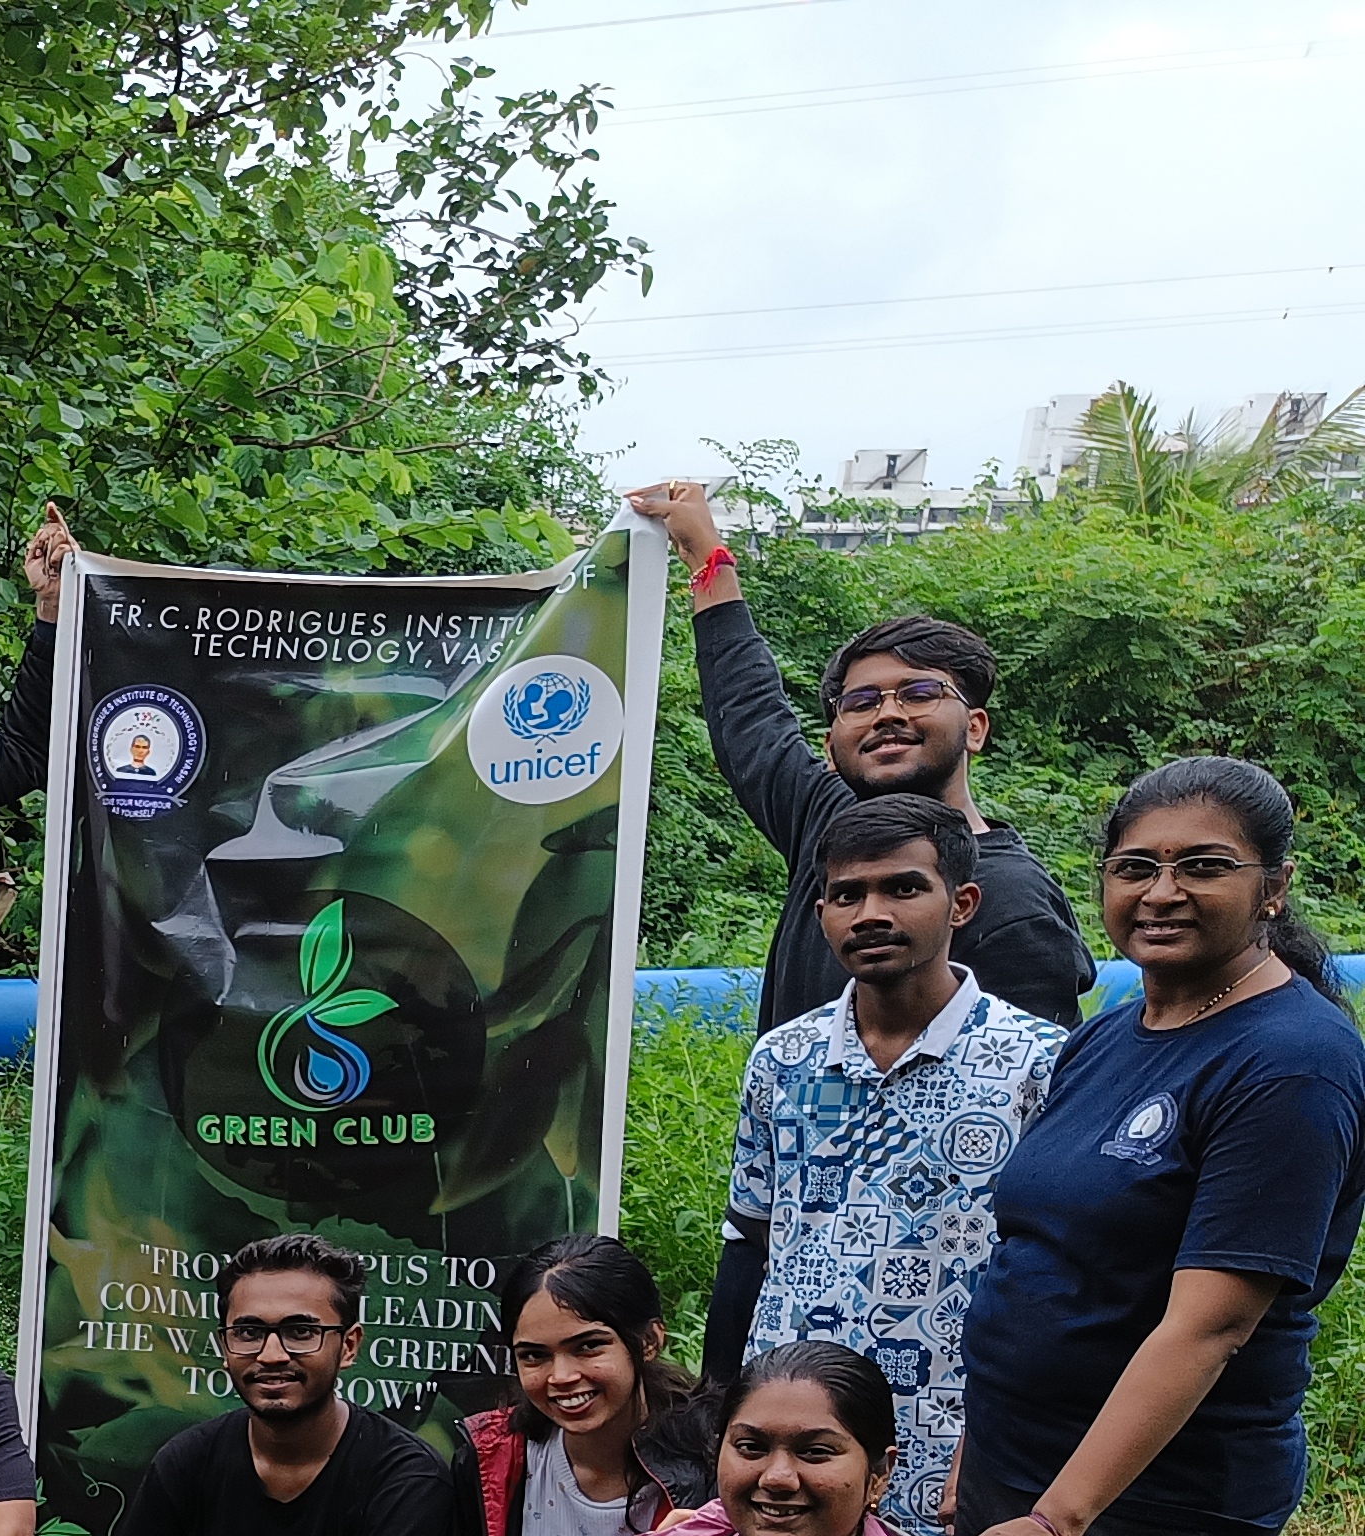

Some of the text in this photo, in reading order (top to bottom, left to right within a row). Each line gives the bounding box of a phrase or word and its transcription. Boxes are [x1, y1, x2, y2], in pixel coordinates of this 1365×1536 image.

[405, 612, 535, 638] INSTITU
[114, 690, 156, 706] INSTITUTE
[490, 742, 602, 785] unicef
[196, 1113, 436, 1147] GREEN CLUB
[358, 1254, 428, 1286] PUS
[441, 1257, 496, 1290] TO
[359, 1295, 502, 1332] LEADIN
[78, 1320, 154, 1352] THE
[164, 1326, 224, 1358] WA
